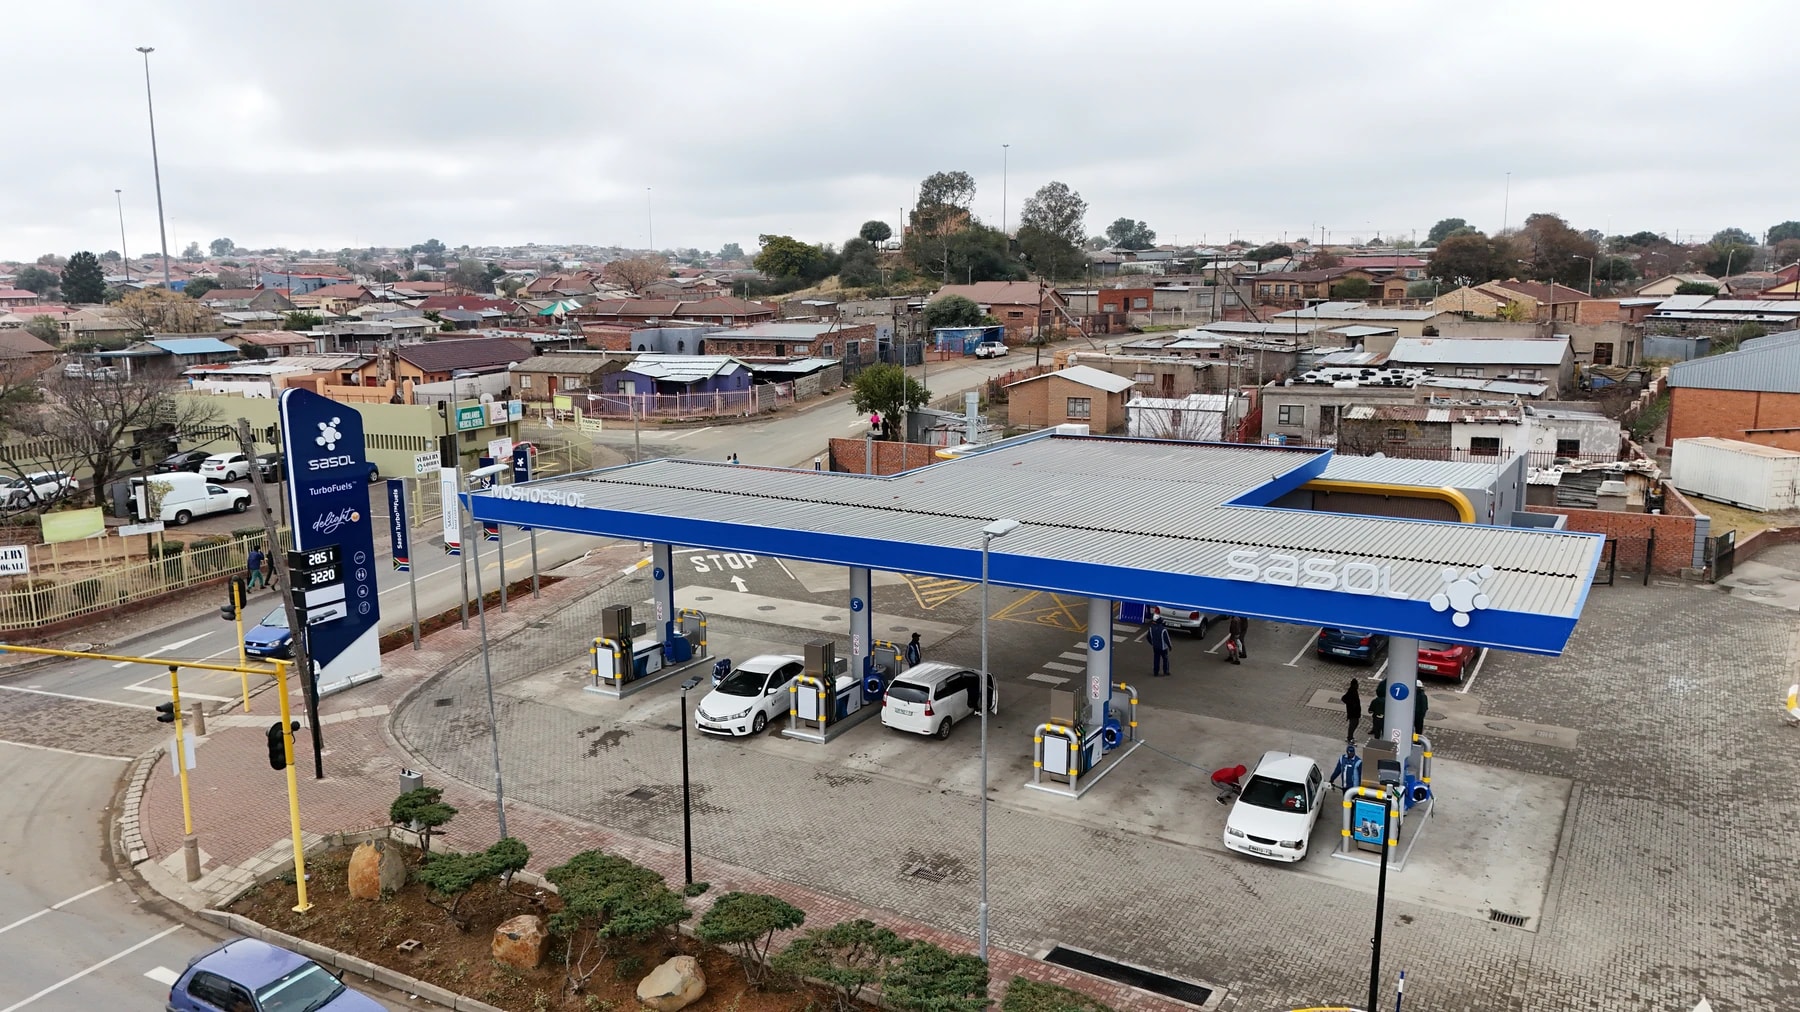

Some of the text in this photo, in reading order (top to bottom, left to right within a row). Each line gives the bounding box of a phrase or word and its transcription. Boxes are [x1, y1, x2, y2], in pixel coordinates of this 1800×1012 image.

[491, 484, 586, 508] MOSHOESHOE
[312, 507, 355, 534] delight
[689, 552, 758, 573] STOP
[853, 601, 859, 609] 5
[1093, 639, 1100, 648] 3
